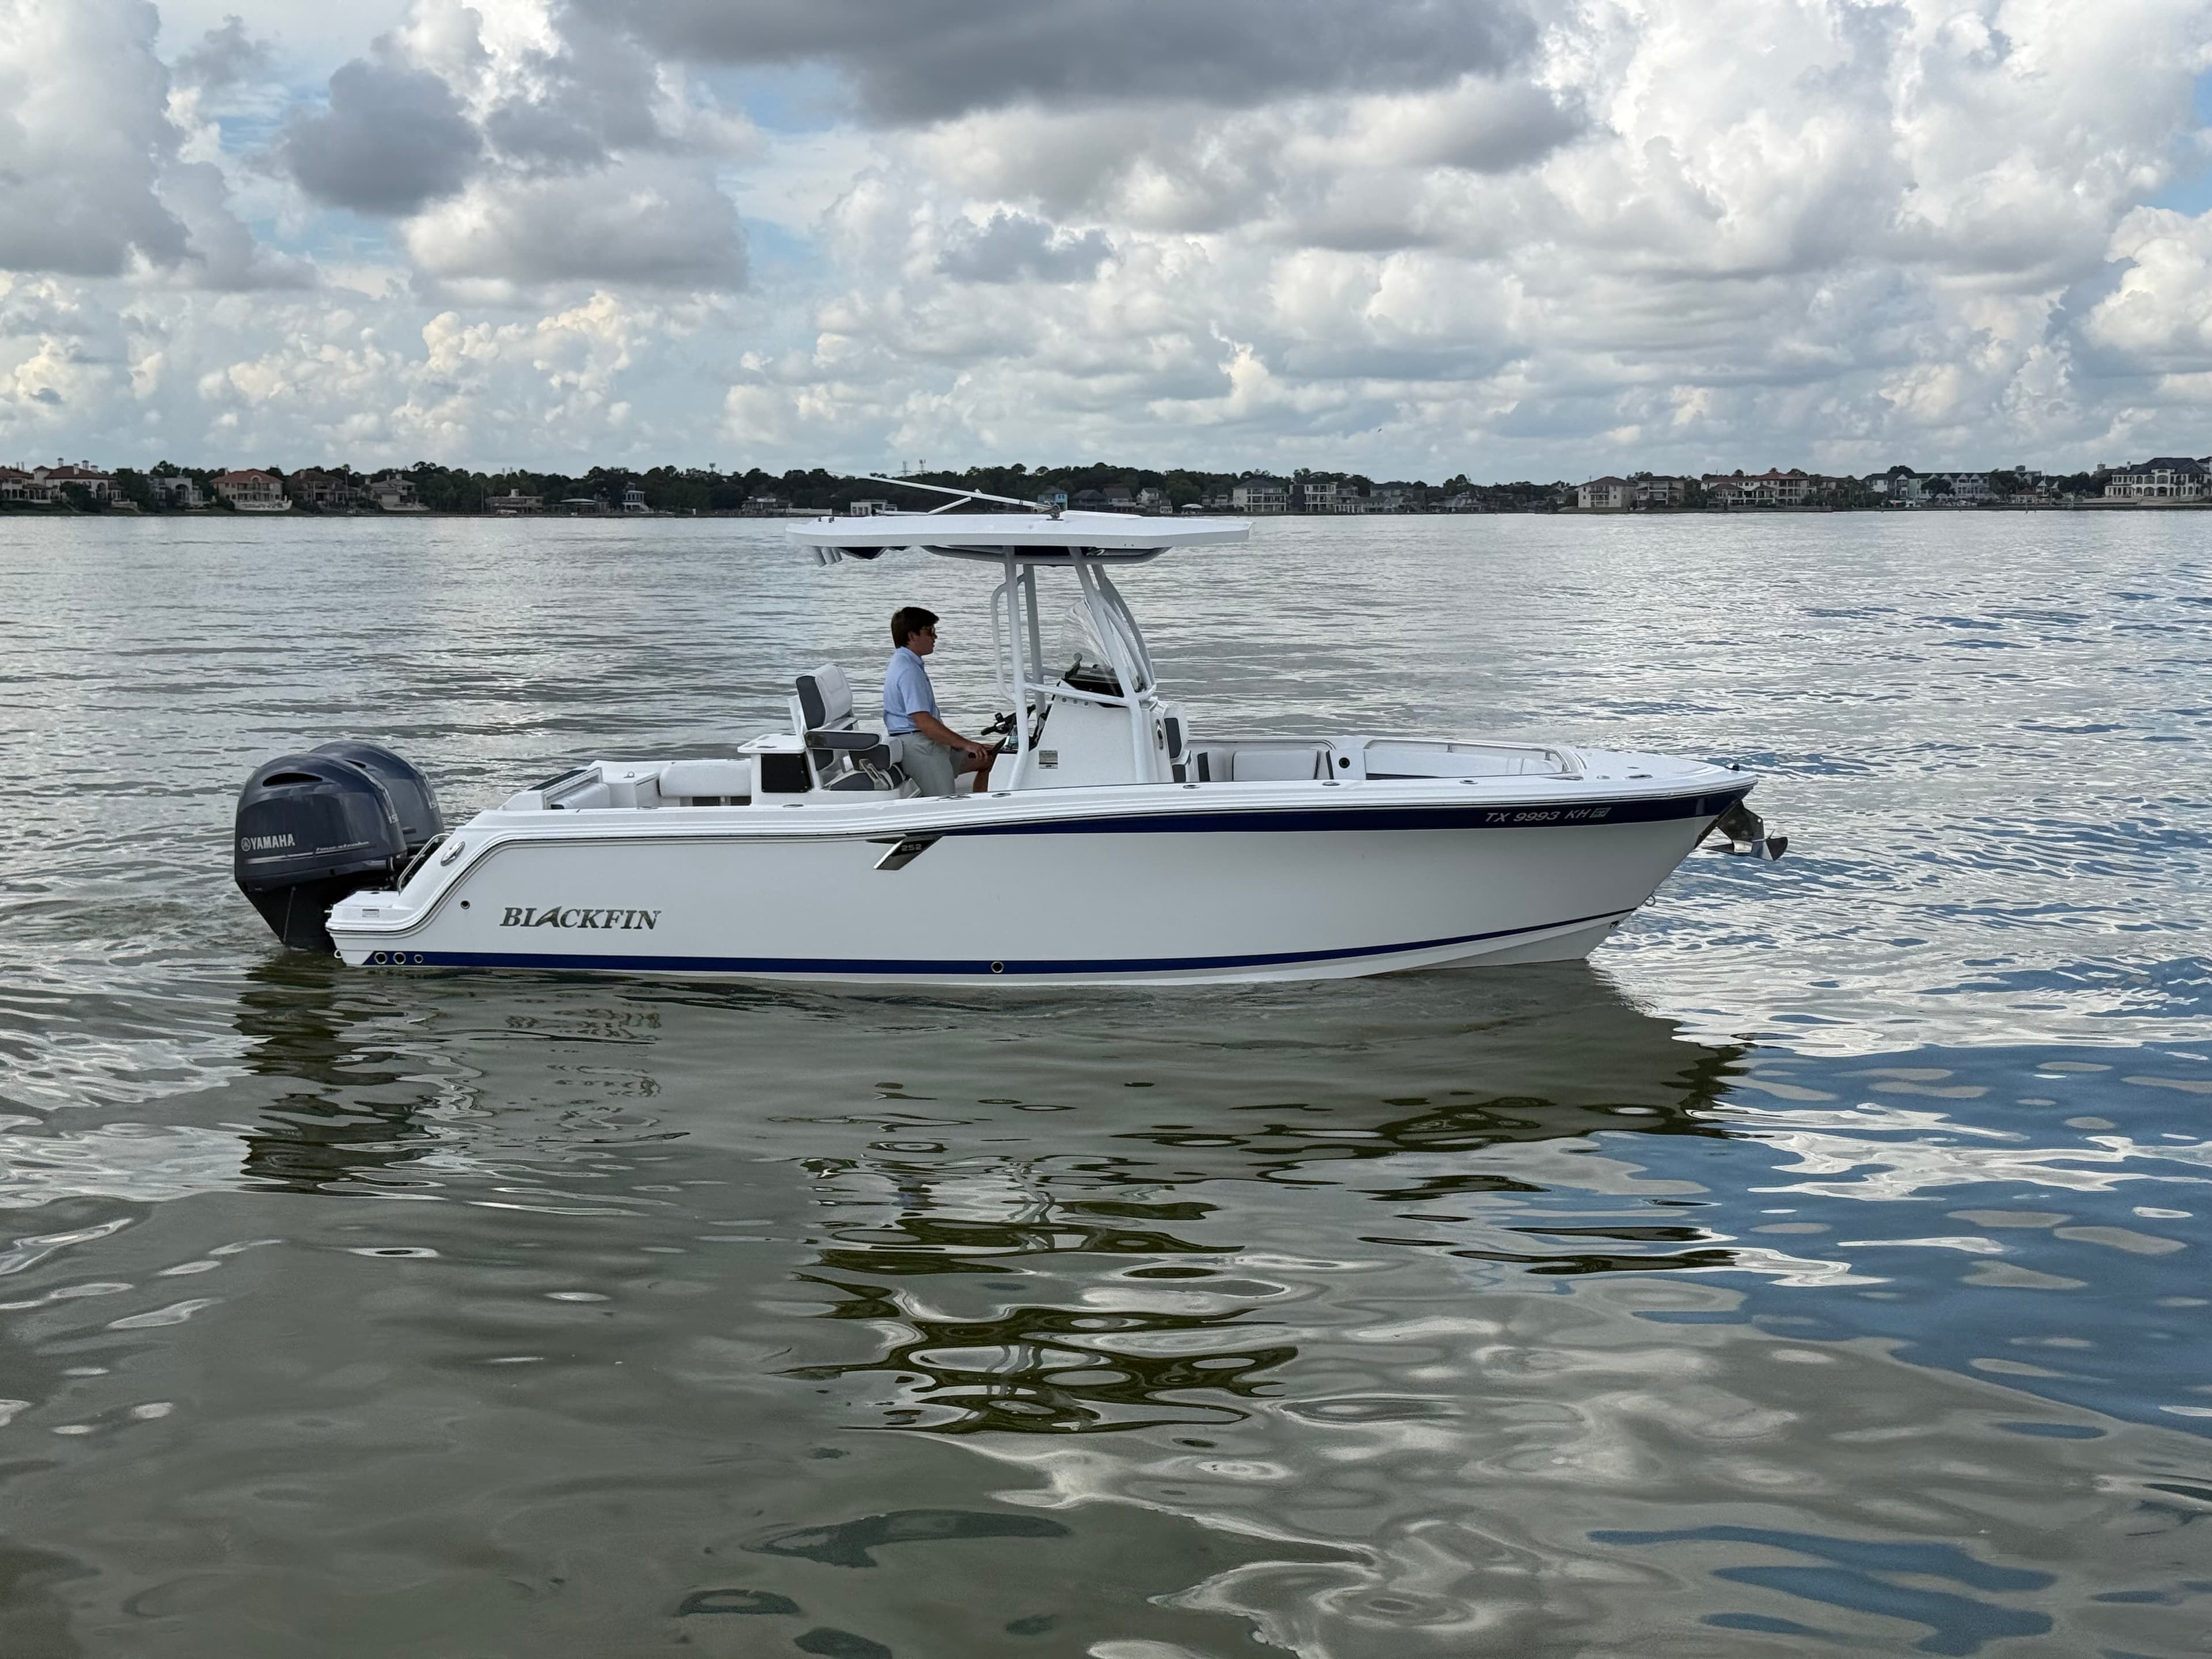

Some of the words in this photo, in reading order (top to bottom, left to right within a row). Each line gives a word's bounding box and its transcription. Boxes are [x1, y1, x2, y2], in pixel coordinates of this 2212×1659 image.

[1485, 812, 1511, 822] TX
[1513, 811, 1560, 821] 9993
[1564, 809, 1591, 819] KH
[250, 834, 296, 850] YAMAHA
[902, 843, 922, 852] 252
[499, 906, 662, 930] BLACKFIN
